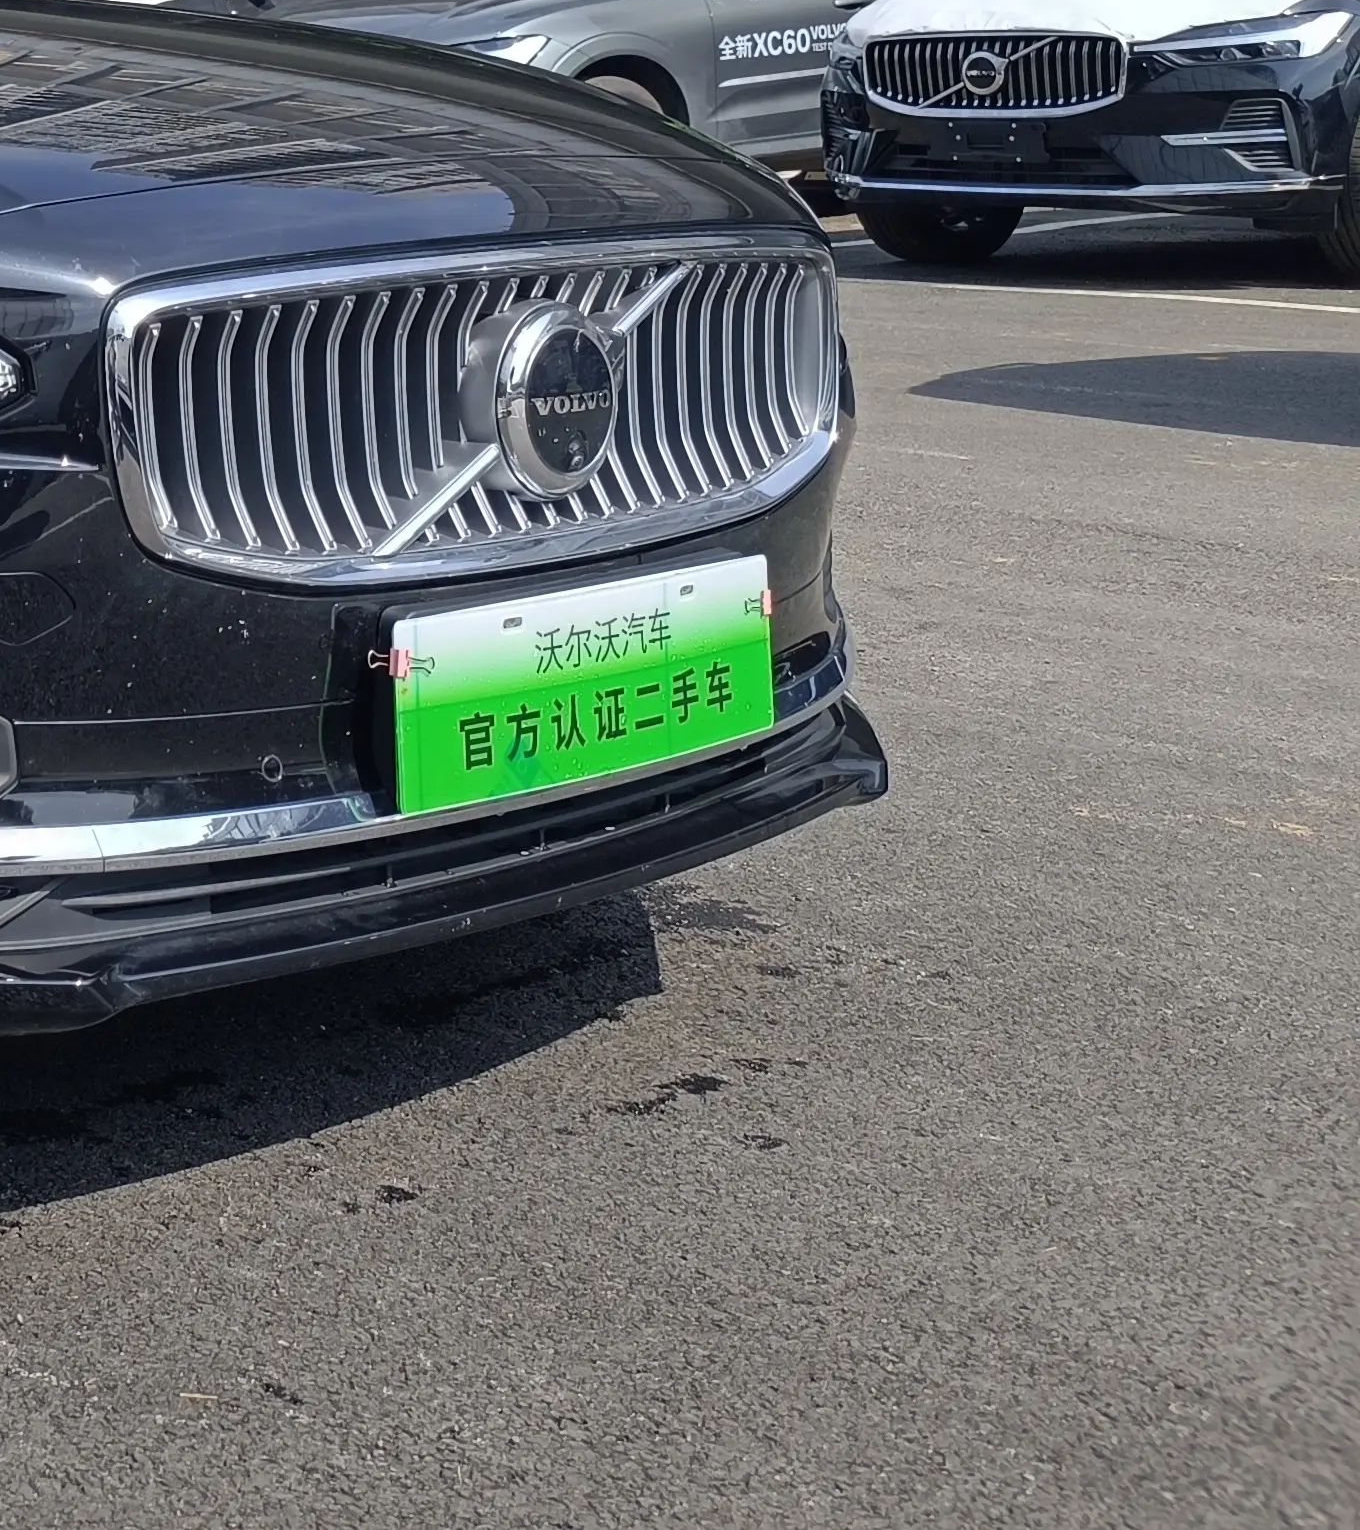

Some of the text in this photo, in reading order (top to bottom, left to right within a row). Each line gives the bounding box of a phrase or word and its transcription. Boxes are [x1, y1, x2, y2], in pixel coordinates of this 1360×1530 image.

[530, 389, 611, 416] VOLVO
[536, 608, 672, 673] 沃尔沃汽车
[459, 661, 733, 771] 官方认证二手车
